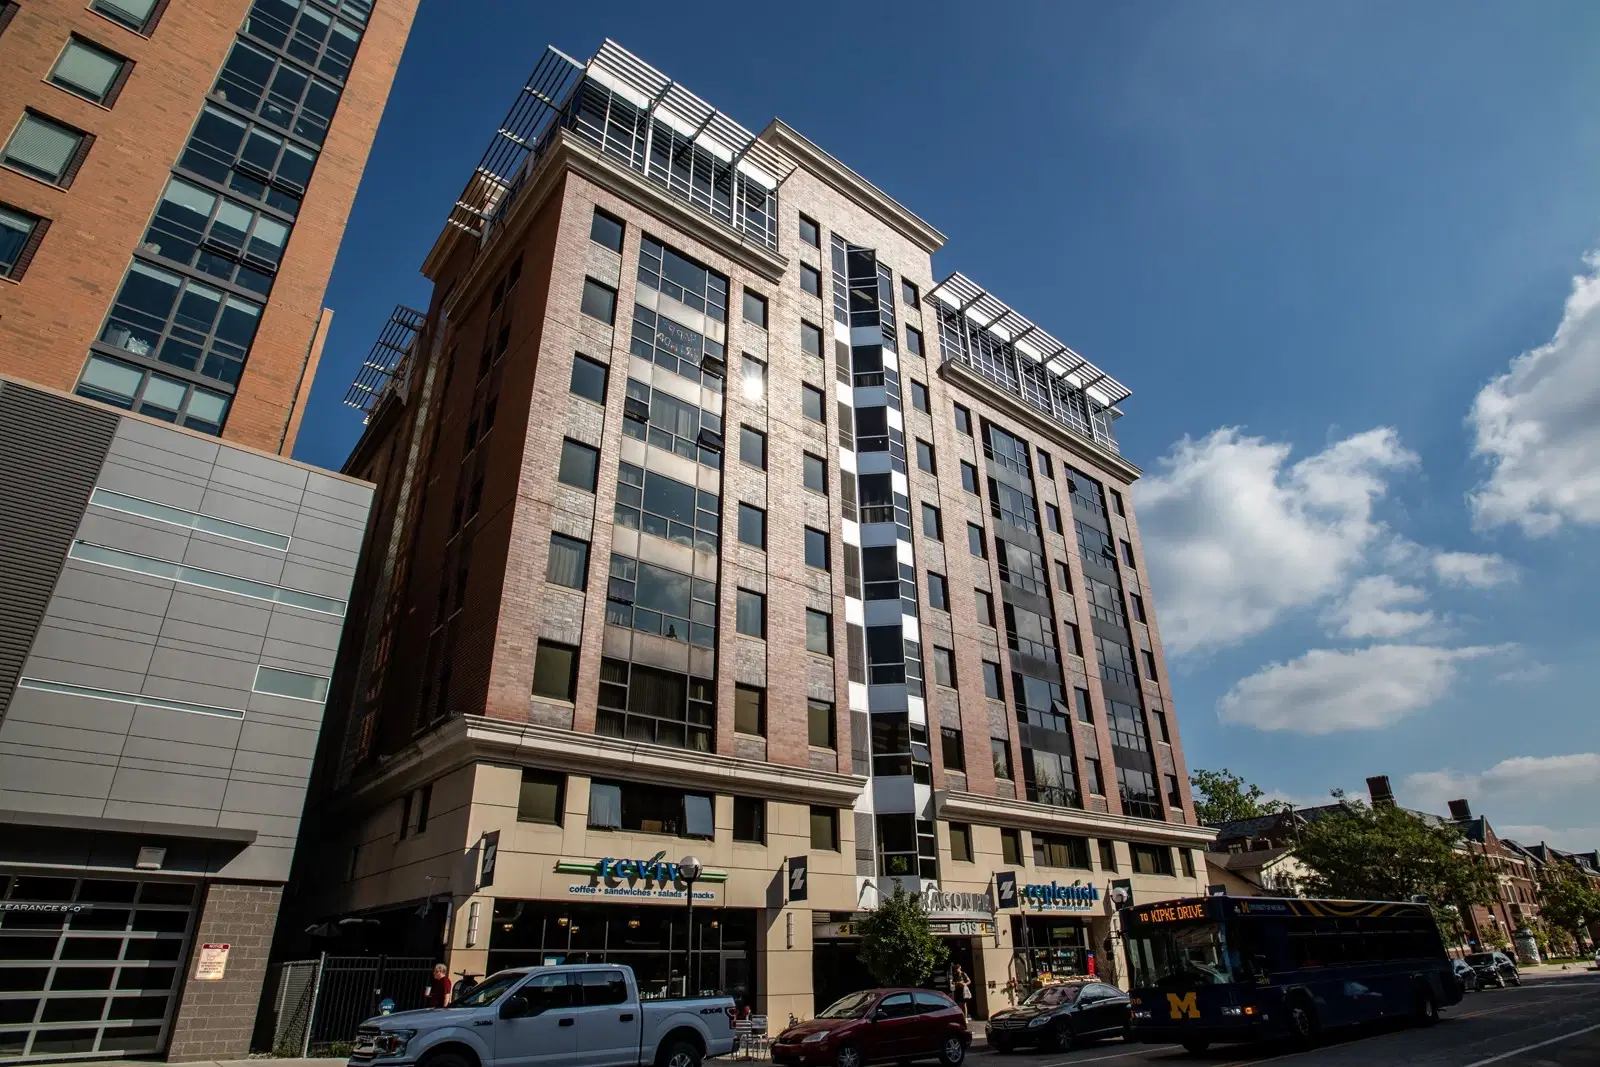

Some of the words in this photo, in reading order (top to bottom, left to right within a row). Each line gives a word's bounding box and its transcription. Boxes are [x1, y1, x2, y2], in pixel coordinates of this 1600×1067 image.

[600, 851, 681, 882] reviv
[568, 885, 596, 894] coffee
[604, 887, 651, 897] sandwiches
[657, 890, 682, 898] salads
[1026, 880, 1099, 905] replenish
[1139, 912, 1149, 922] TO
[1150, 907, 1177, 923] KIPKE
[1176, 904, 1205, 920] DRIVE
[1166, 991, 1201, 1019] M
